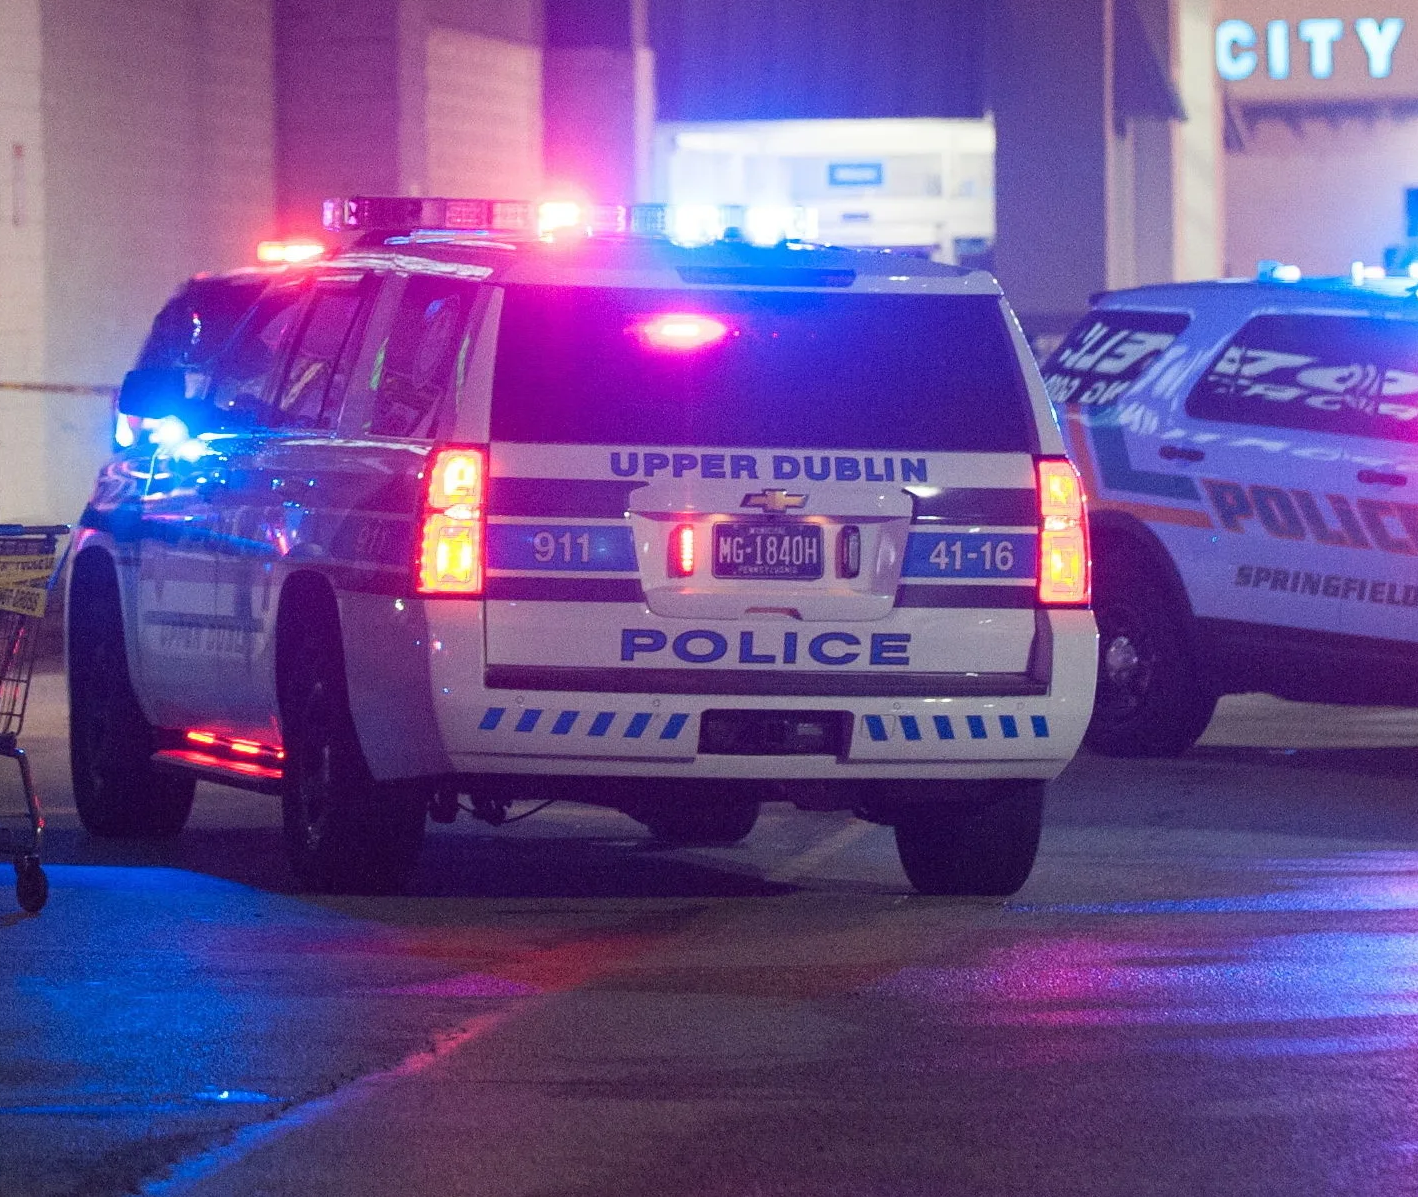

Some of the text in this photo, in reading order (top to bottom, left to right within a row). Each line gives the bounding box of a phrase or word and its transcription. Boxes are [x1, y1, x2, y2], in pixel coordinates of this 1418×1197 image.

[1214, 17, 1404, 80] CITY
[610, 451, 928, 482] UPPER DUBLIN
[533, 531, 590, 563] 911
[719, 535, 817, 565] MG-1840H
[929, 540, 1015, 571] 41-16
[620, 627, 912, 666] POLICE
